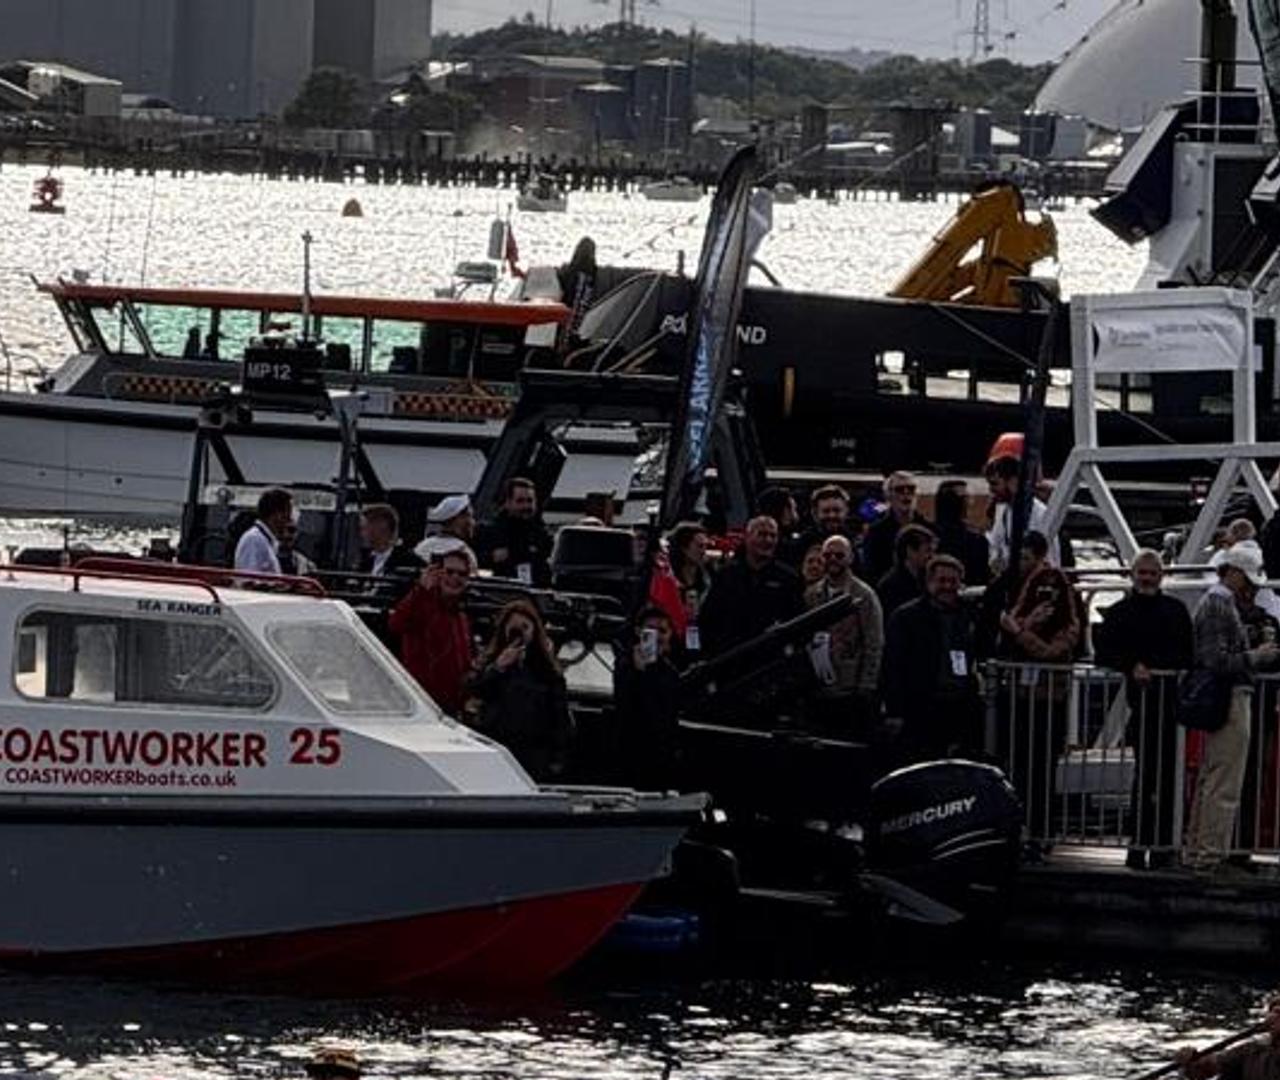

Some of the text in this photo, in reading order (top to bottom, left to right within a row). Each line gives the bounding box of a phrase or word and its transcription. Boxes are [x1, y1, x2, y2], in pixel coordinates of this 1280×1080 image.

[247, 362, 292, 380] MP12
[290, 729, 341, 764] 25
[5, 768, 236, 787] COASTWORKERboats.co.uk
[880, 796, 977, 834] MERCURY
